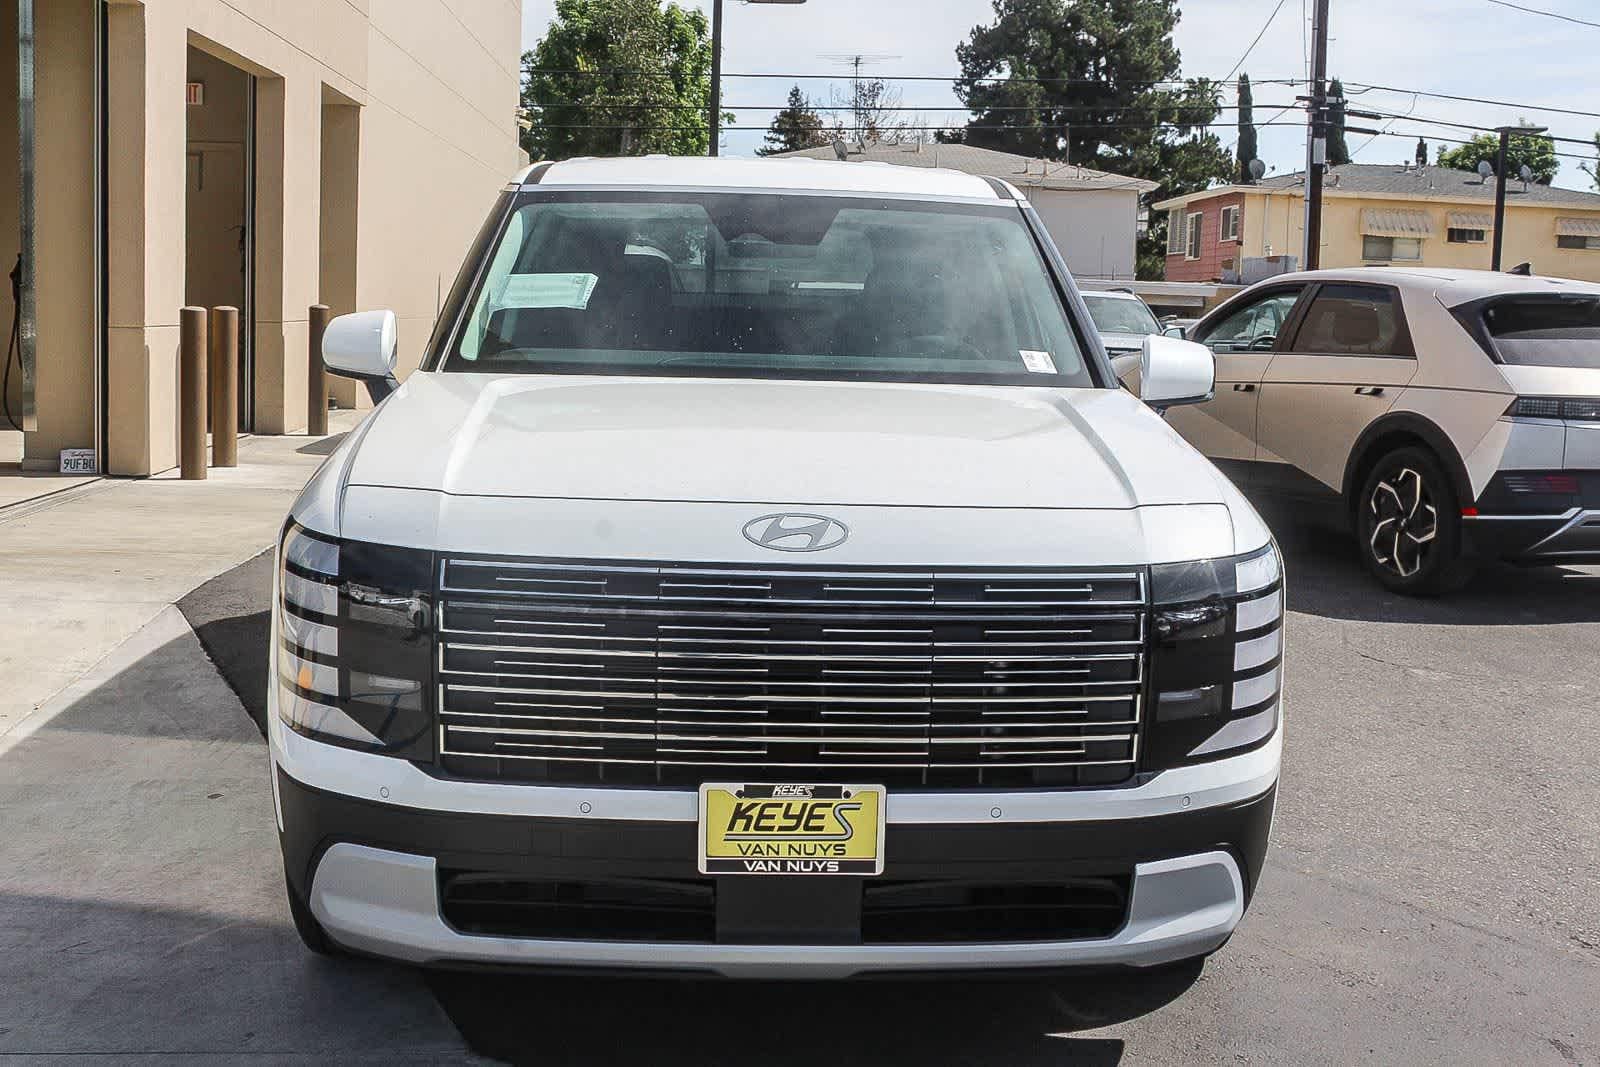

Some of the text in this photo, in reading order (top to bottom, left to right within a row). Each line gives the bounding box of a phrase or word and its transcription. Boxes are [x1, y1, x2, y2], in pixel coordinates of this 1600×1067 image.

[188, 84, 199, 103] IT
[772, 785, 815, 799] KEYES
[724, 802, 863, 841] KEYES
[737, 843, 846, 856] VAN NUYS
[744, 860, 839, 872] VAN NUYS
